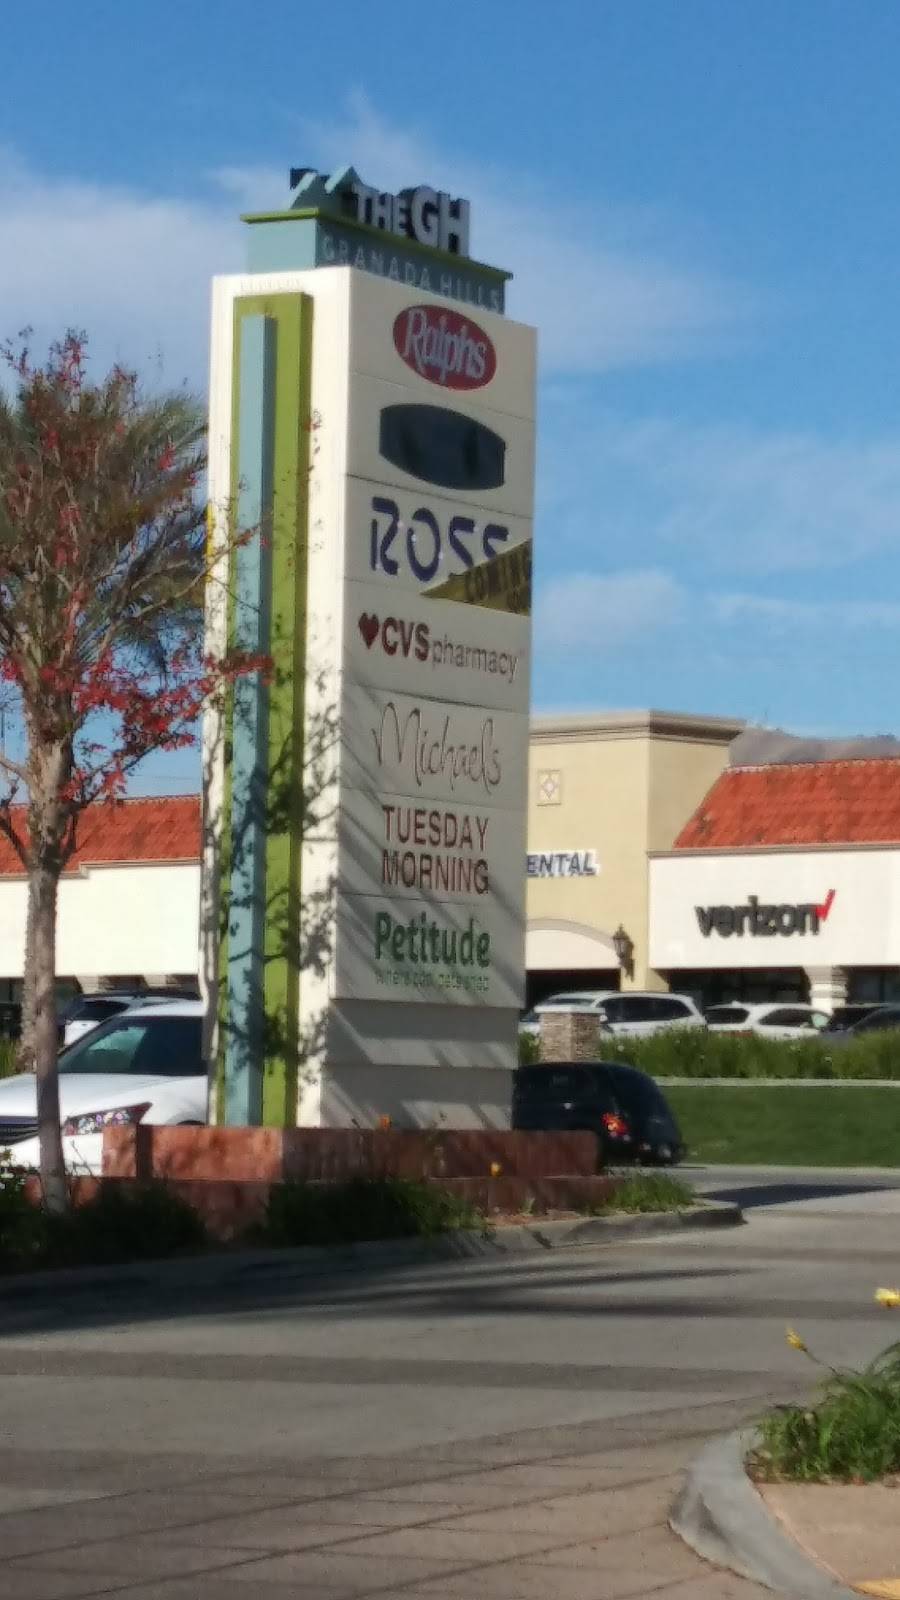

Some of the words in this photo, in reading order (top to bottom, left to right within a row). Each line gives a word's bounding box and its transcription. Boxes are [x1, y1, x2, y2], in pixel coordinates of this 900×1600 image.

[322, 234, 432, 291] GRANADA
[440, 272, 501, 312] HILLS
[403, 307, 487, 384] Ralphs
[381, 617, 431, 661] CVS
[432, 634, 519, 684] pharmacy
[371, 702, 501, 795] Michaels
[382, 804, 489, 851] TUESDAY
[382, 849, 489, 894] MORNING
[375, 910, 491, 968] Petitude
[694, 894, 820, 938] verizon
